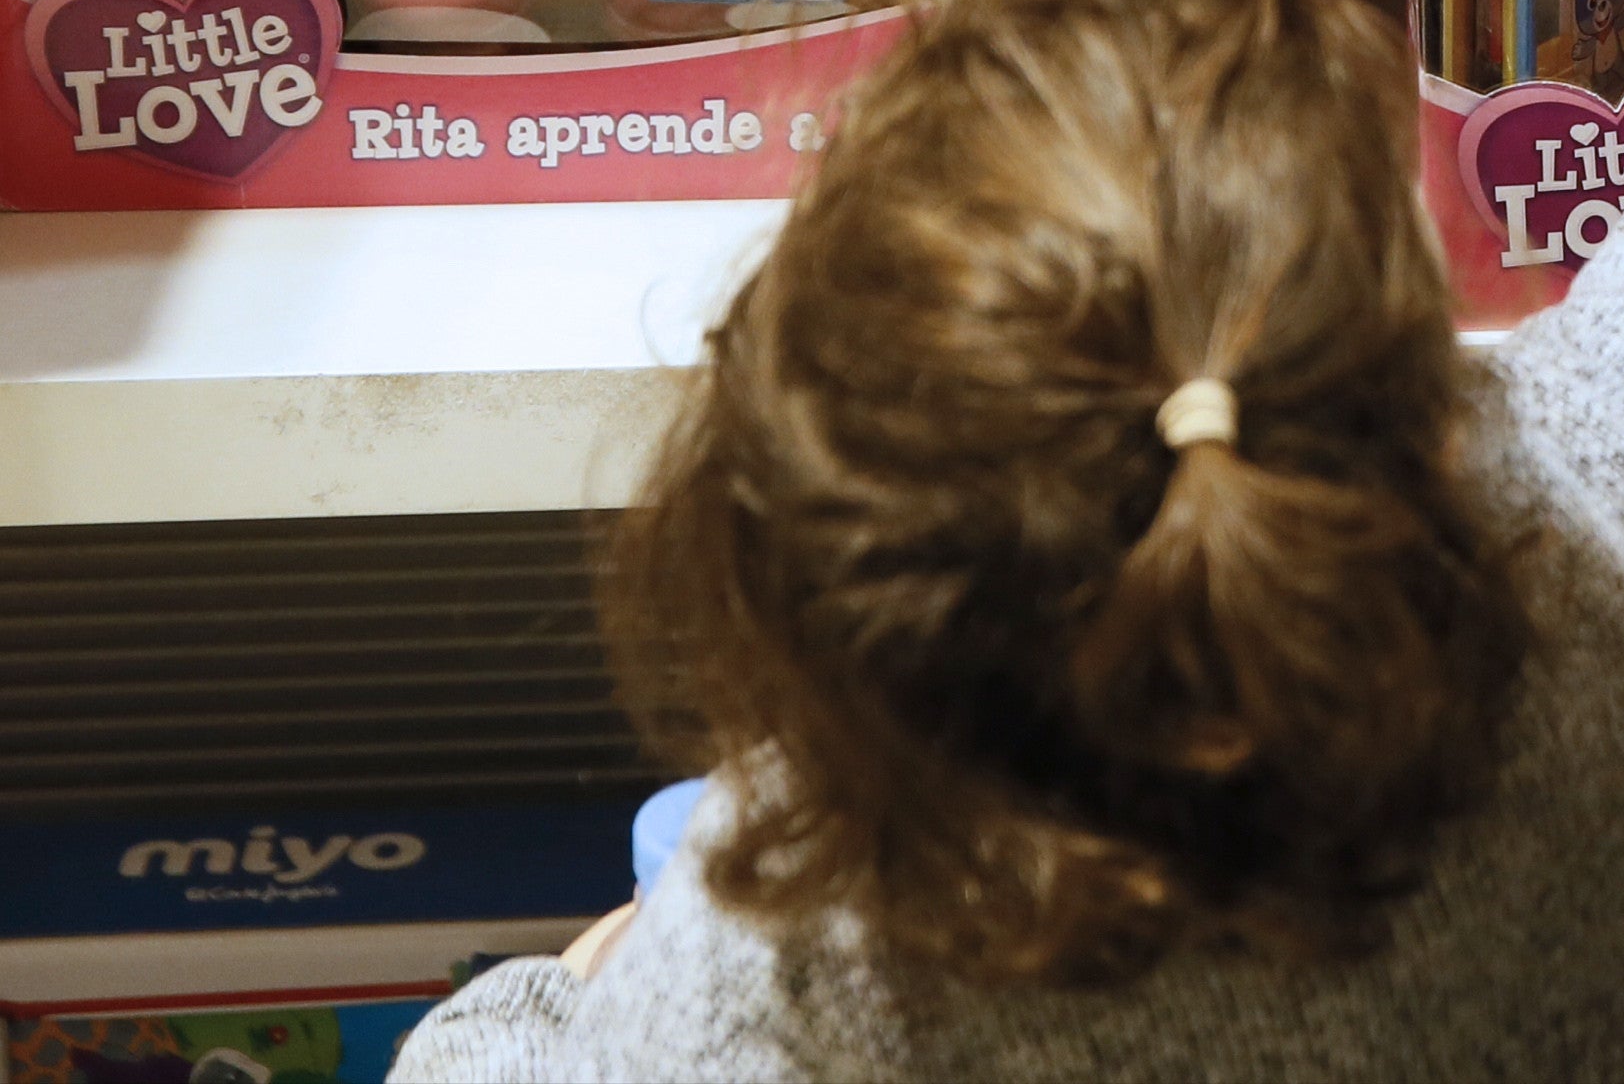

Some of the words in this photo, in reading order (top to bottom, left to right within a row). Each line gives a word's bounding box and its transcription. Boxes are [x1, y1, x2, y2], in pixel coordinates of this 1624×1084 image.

[103, 7, 293, 78] Little
[64, 64, 323, 151] Love
[349, 103, 485, 160] Rita
[507, 99, 763, 168] aprende
[118, 825, 427, 883] miyo
